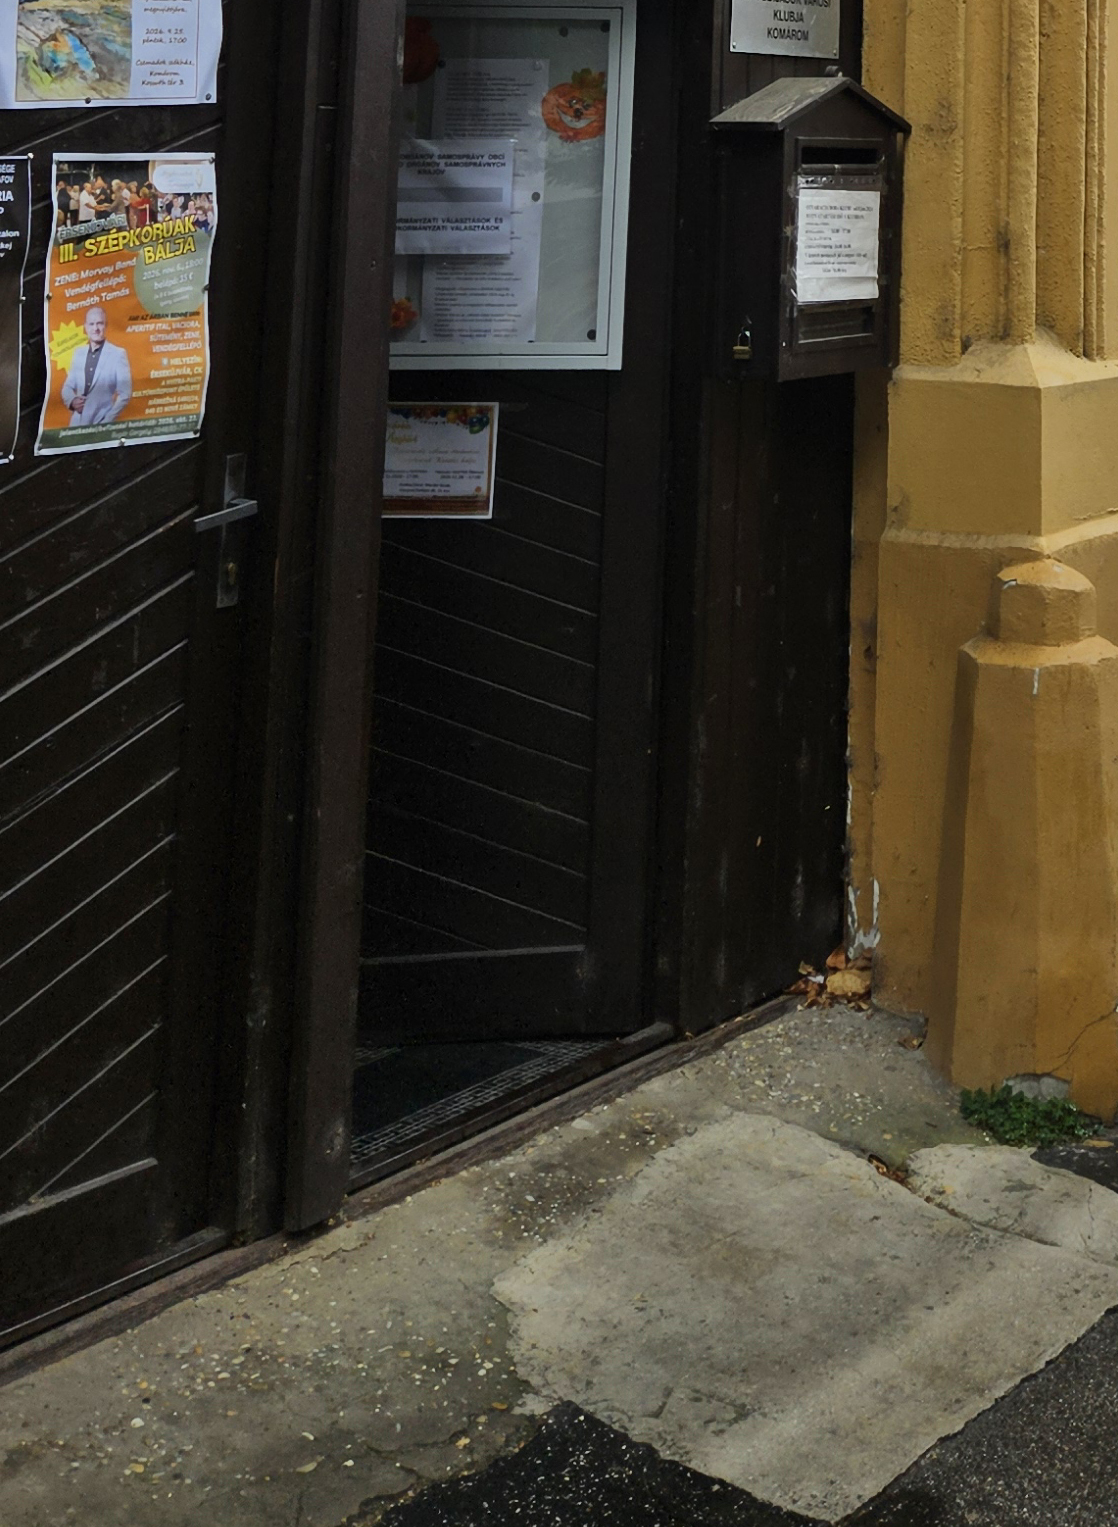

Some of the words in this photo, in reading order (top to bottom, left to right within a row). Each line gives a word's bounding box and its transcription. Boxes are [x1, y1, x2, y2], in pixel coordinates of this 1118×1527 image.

[773, 9, 804, 23] KLUBJA
[767, 26, 809, 41] KOMÁROM
[59, 242, 78, 264] III.
[84, 215, 196, 257] SZÉPKORÚAK
[143, 235, 196, 265] BÁLJA
[54, 272, 79, 287] ZENE:
[80, 264, 114, 279] Morvay
[115, 256, 137, 270] Band
[66, 296, 100, 312] Bernáth
[101, 288, 130, 301] Tamás
